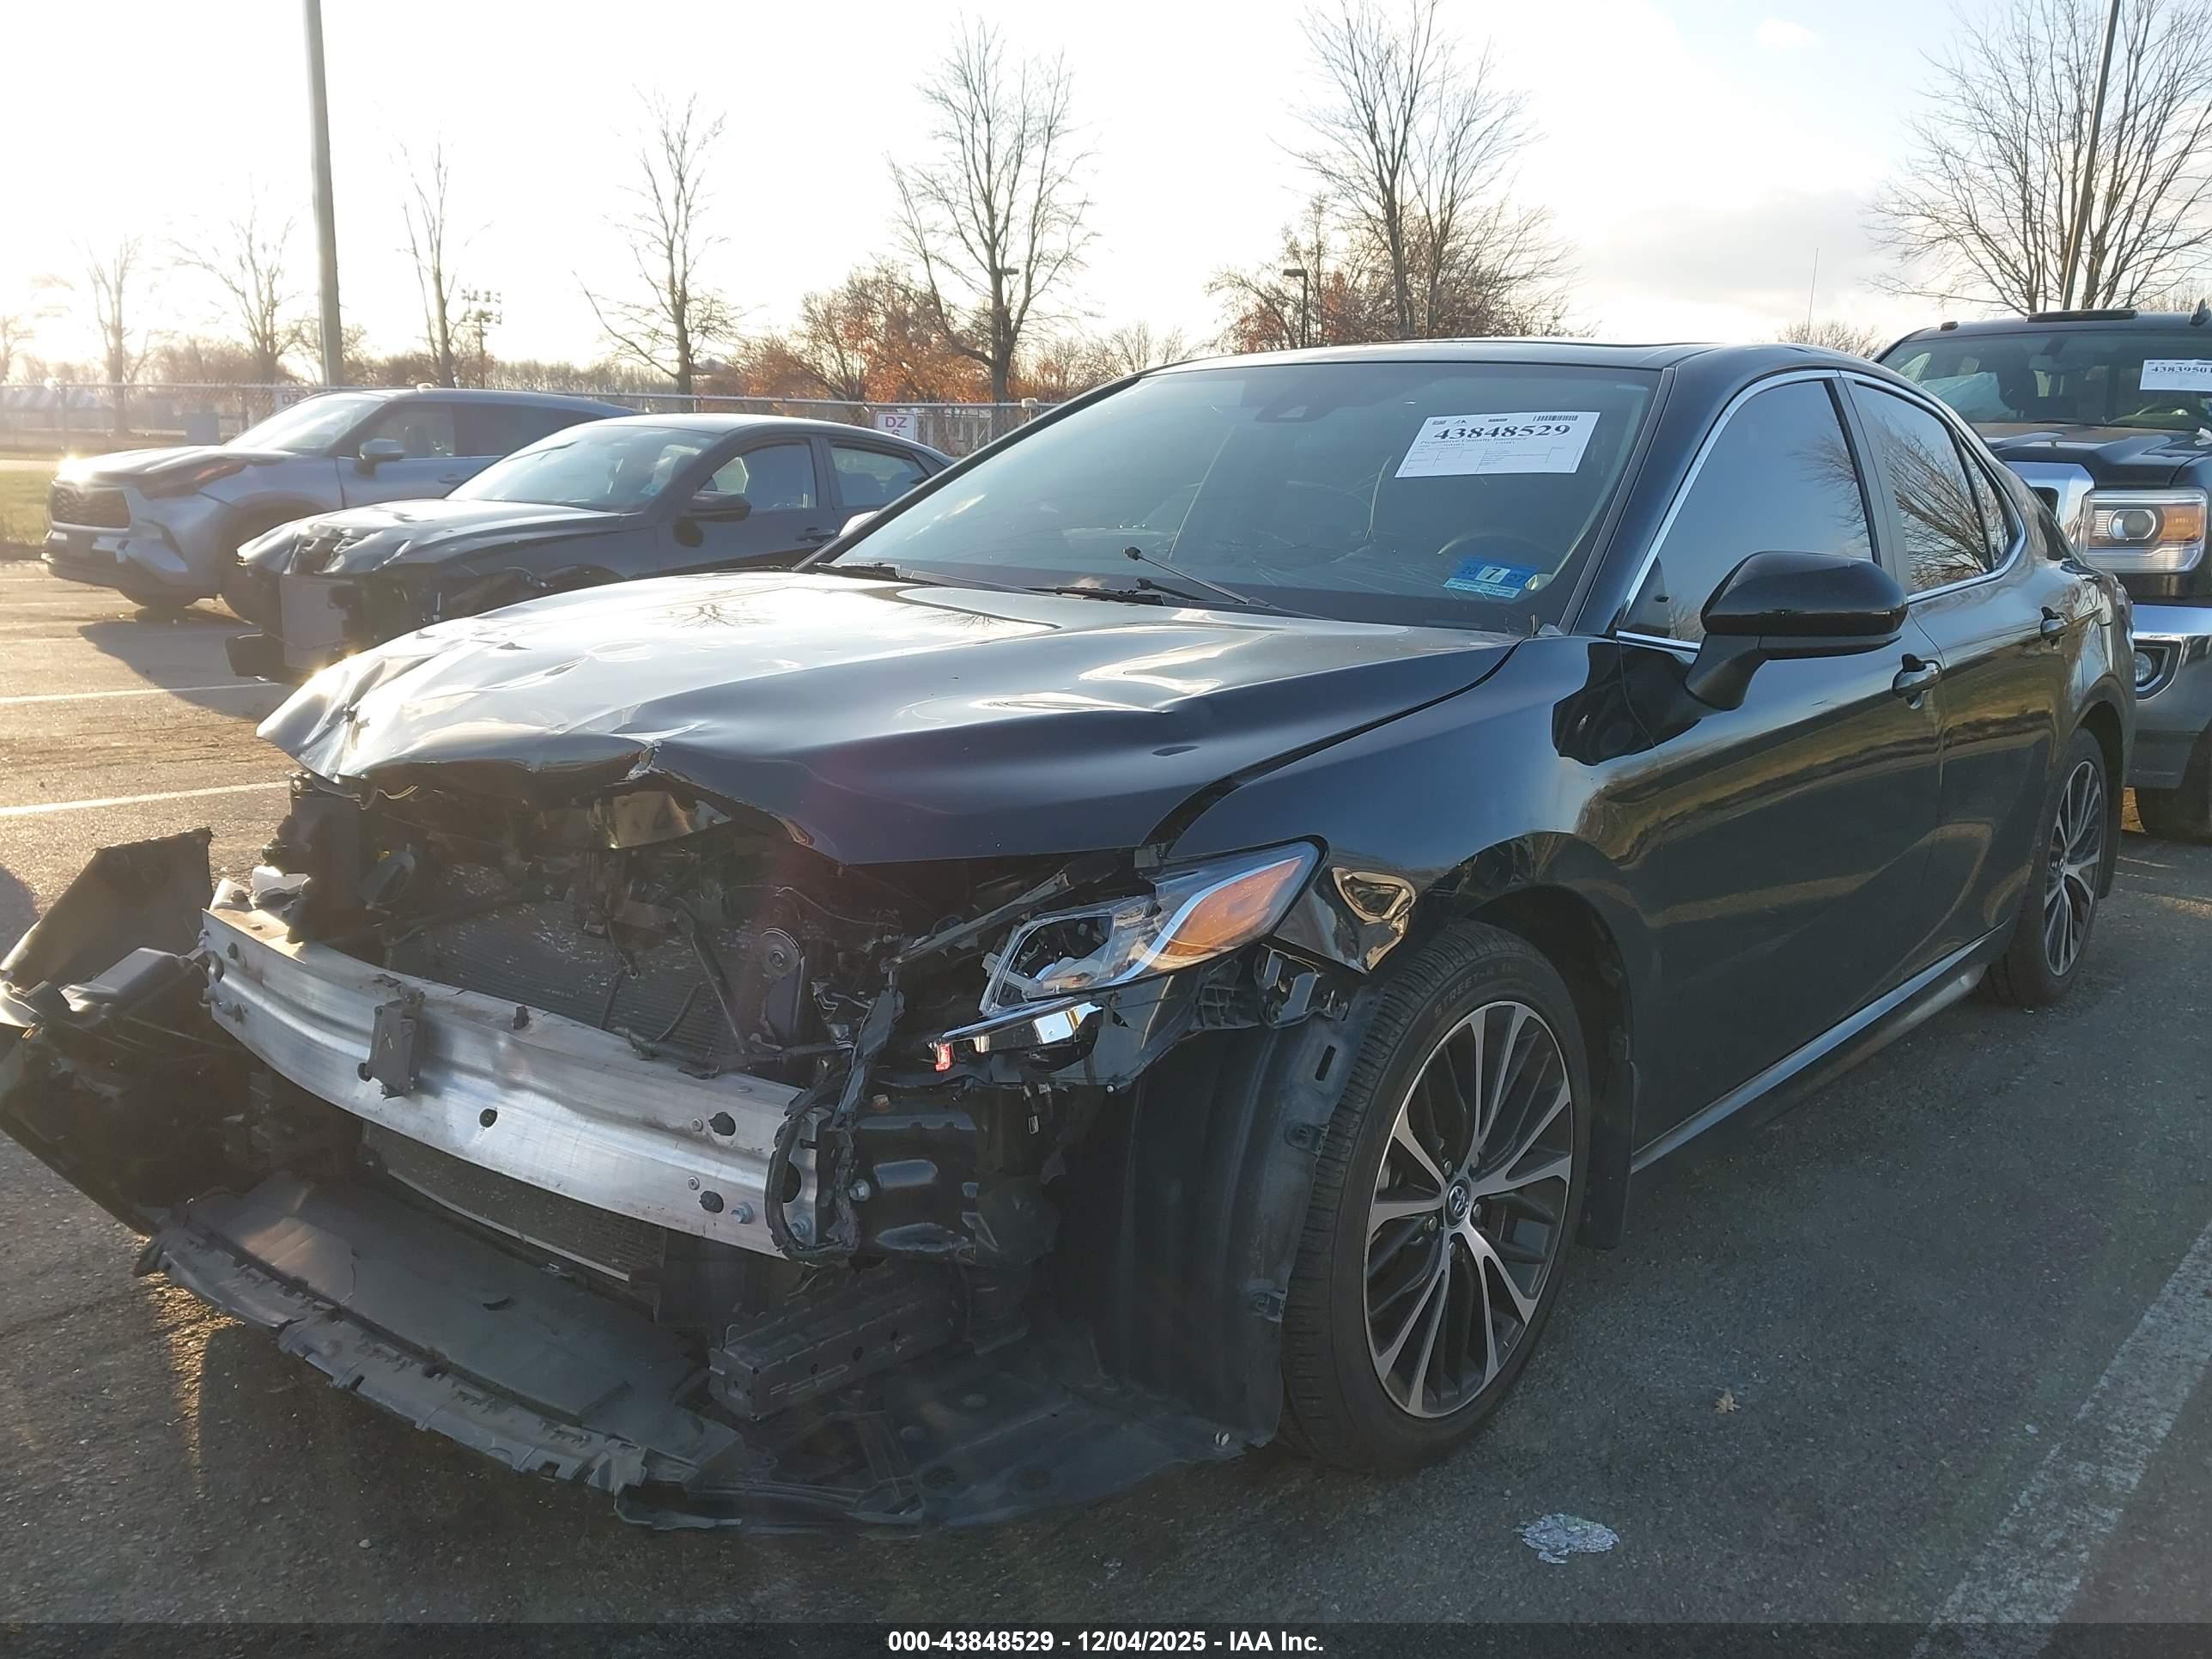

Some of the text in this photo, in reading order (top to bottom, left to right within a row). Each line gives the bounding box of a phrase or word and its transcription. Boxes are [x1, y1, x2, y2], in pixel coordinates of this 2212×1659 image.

[885, 416, 908, 428] DZ
[1434, 424, 1571, 440] 43848529
[1486, 568, 1501, 580] 7
